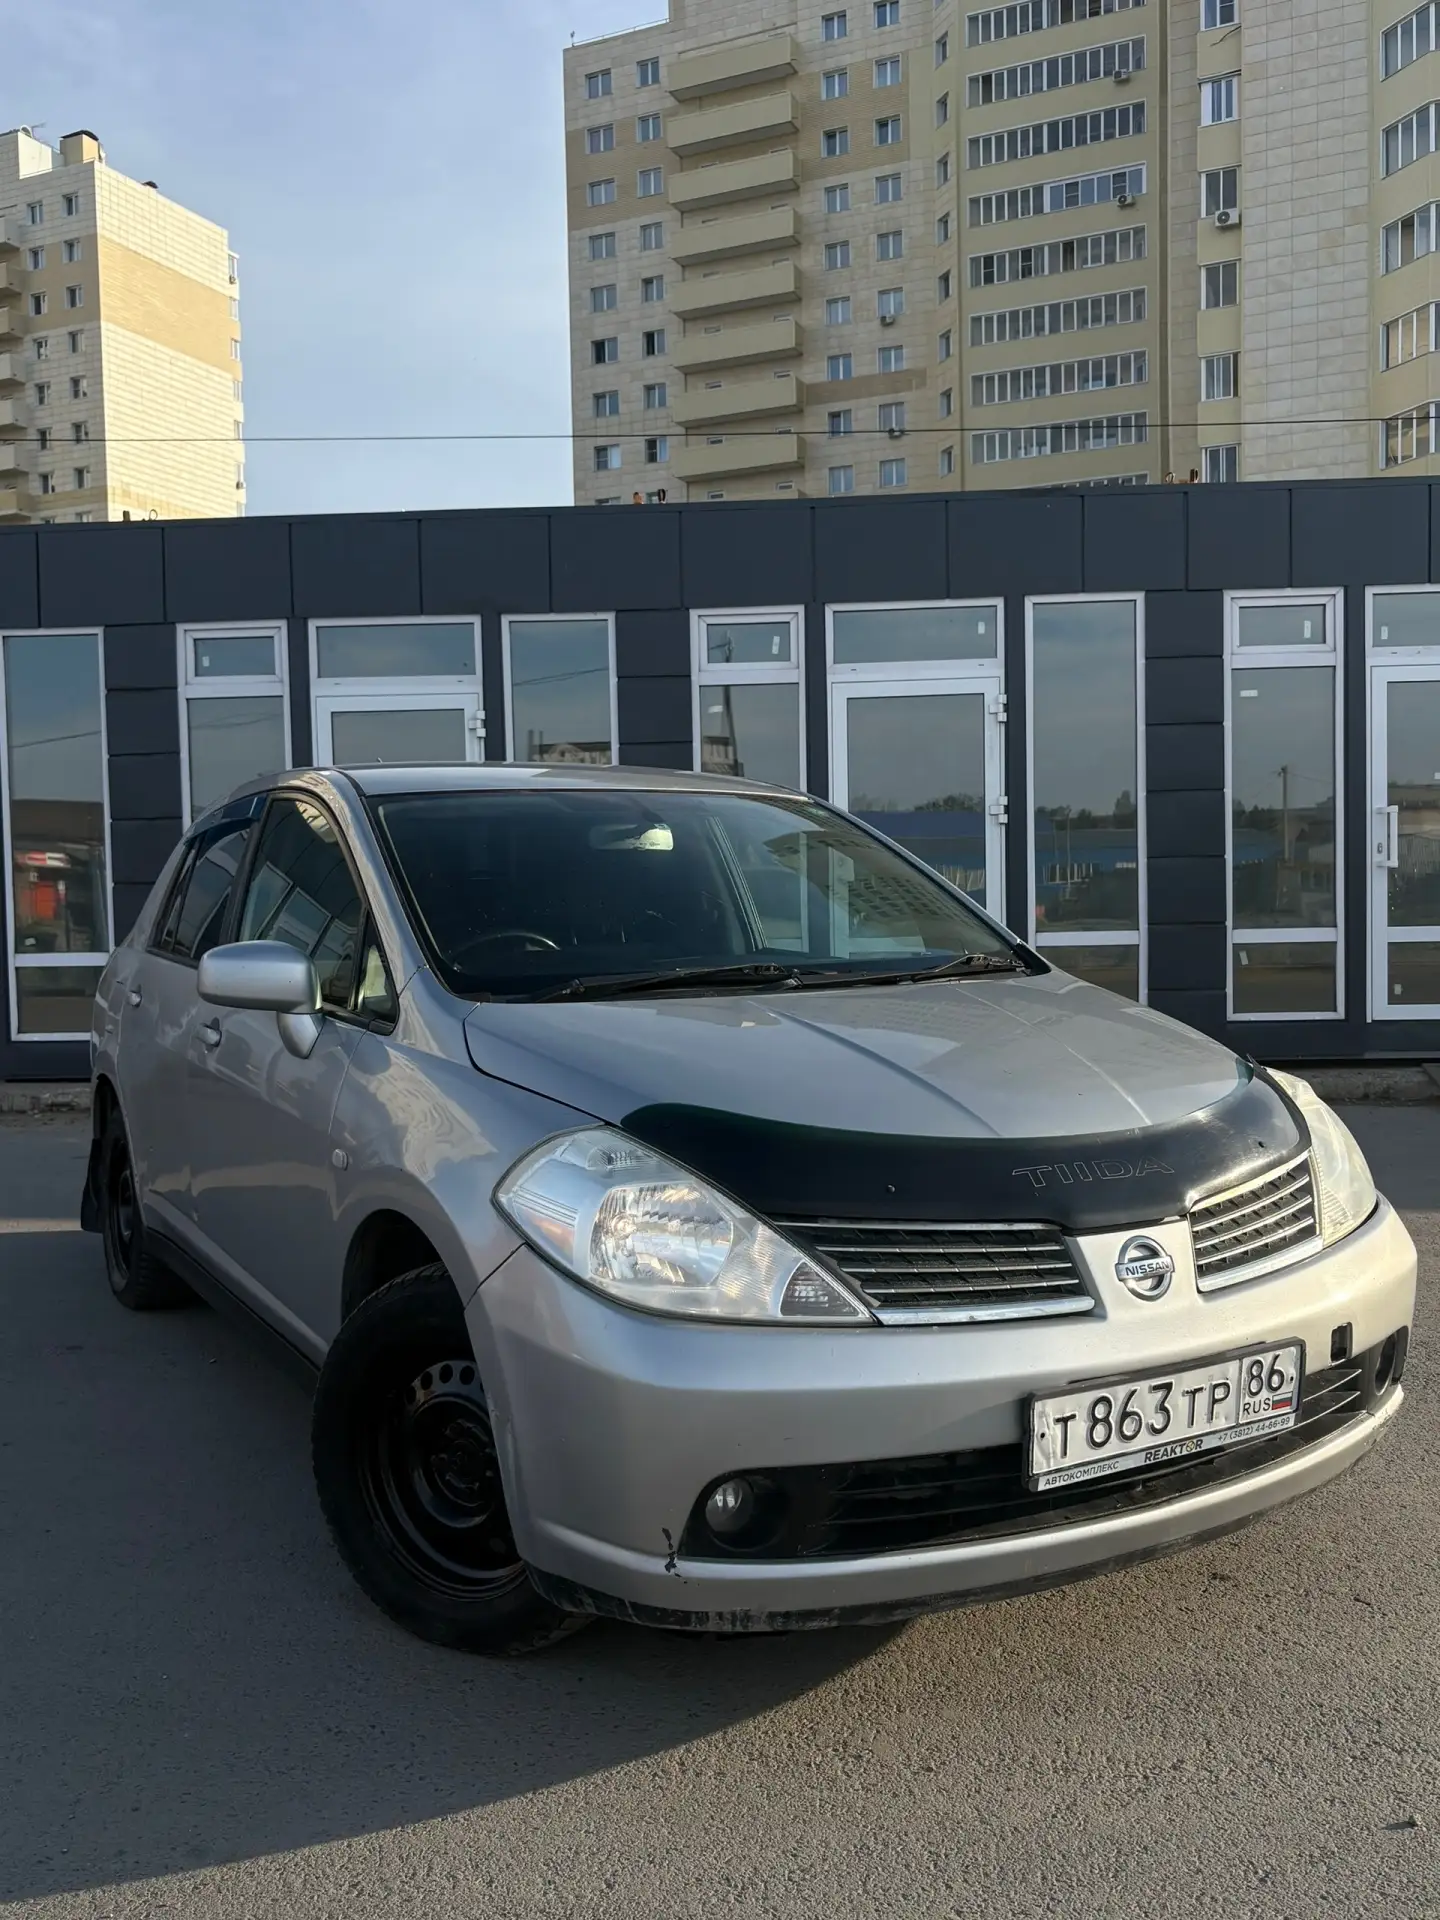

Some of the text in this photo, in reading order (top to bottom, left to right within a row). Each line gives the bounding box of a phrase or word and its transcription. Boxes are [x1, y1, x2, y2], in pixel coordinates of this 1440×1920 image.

[1012, 1156, 1174, 1187] TIIDA
[1125, 1260, 1170, 1276] NISSAN
[1248, 1354, 1285, 1397] 86
[1243, 1397, 1271, 1415] RUS
[1044, 1460, 1120, 1486] АВТОКОМПЛЕКС
[1144, 1438, 1204, 1463] REAKTOR
